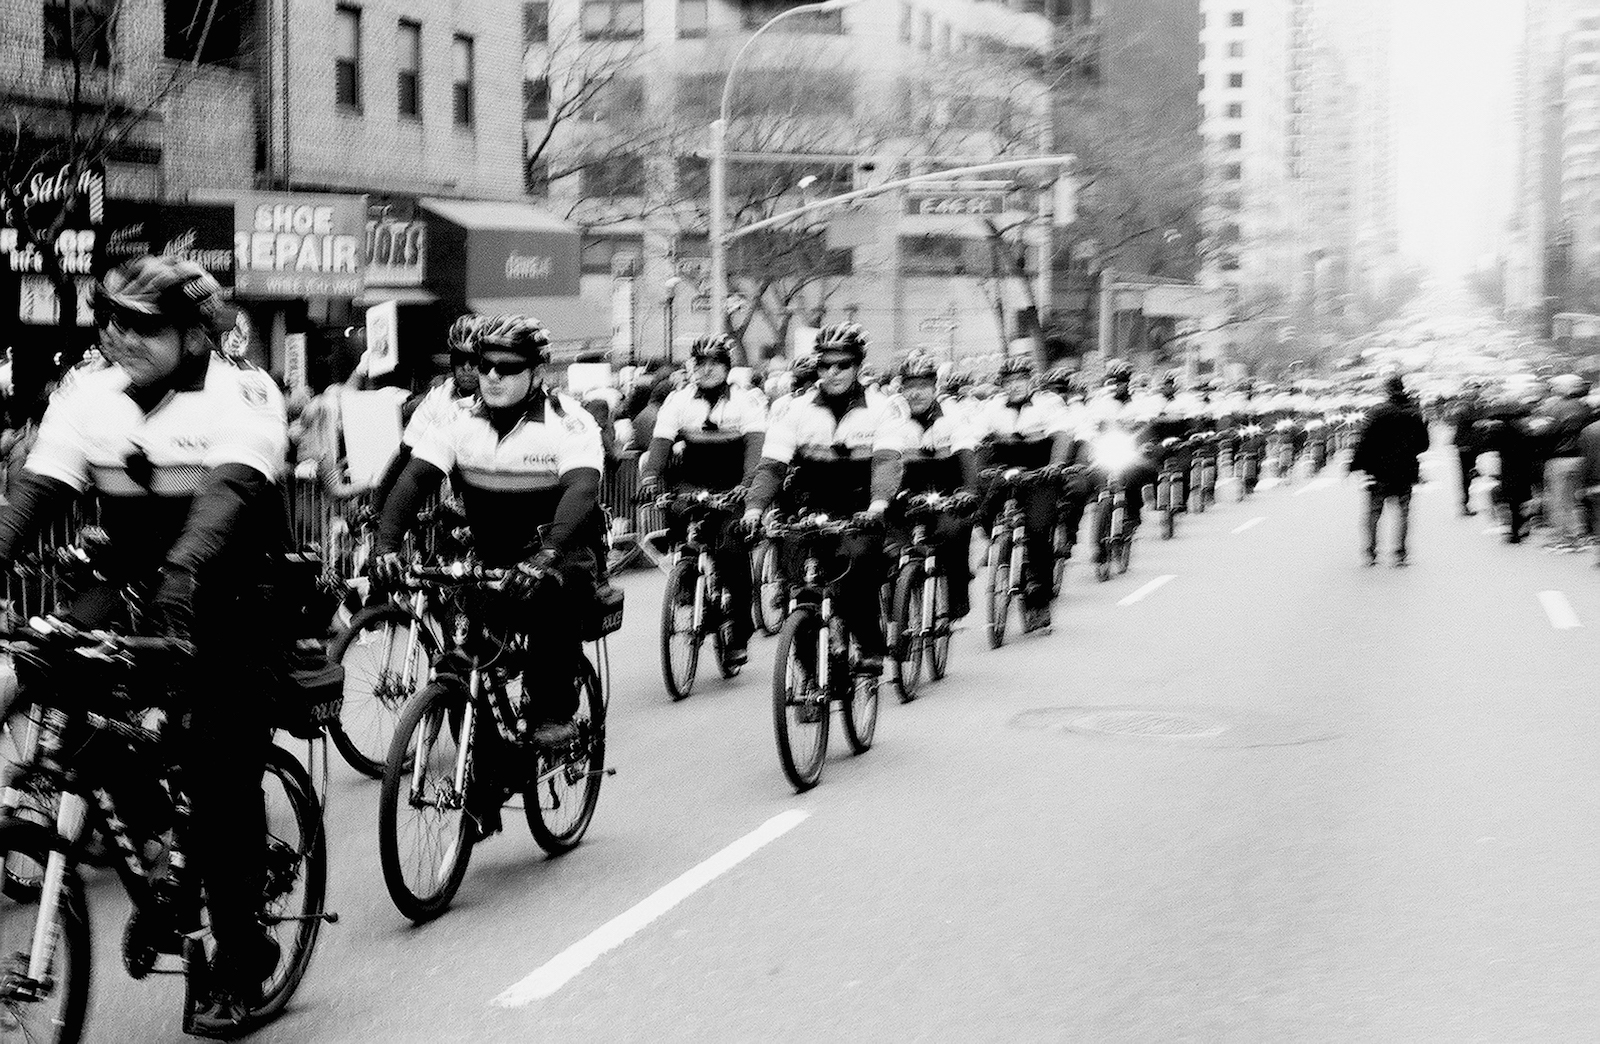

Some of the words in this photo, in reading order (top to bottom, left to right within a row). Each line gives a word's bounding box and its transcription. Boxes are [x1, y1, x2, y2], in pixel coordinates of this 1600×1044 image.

[254, 203, 333, 236] SHOE
[234, 230, 357, 274] REPAIR
[523, 453, 557, 464] POLICE
